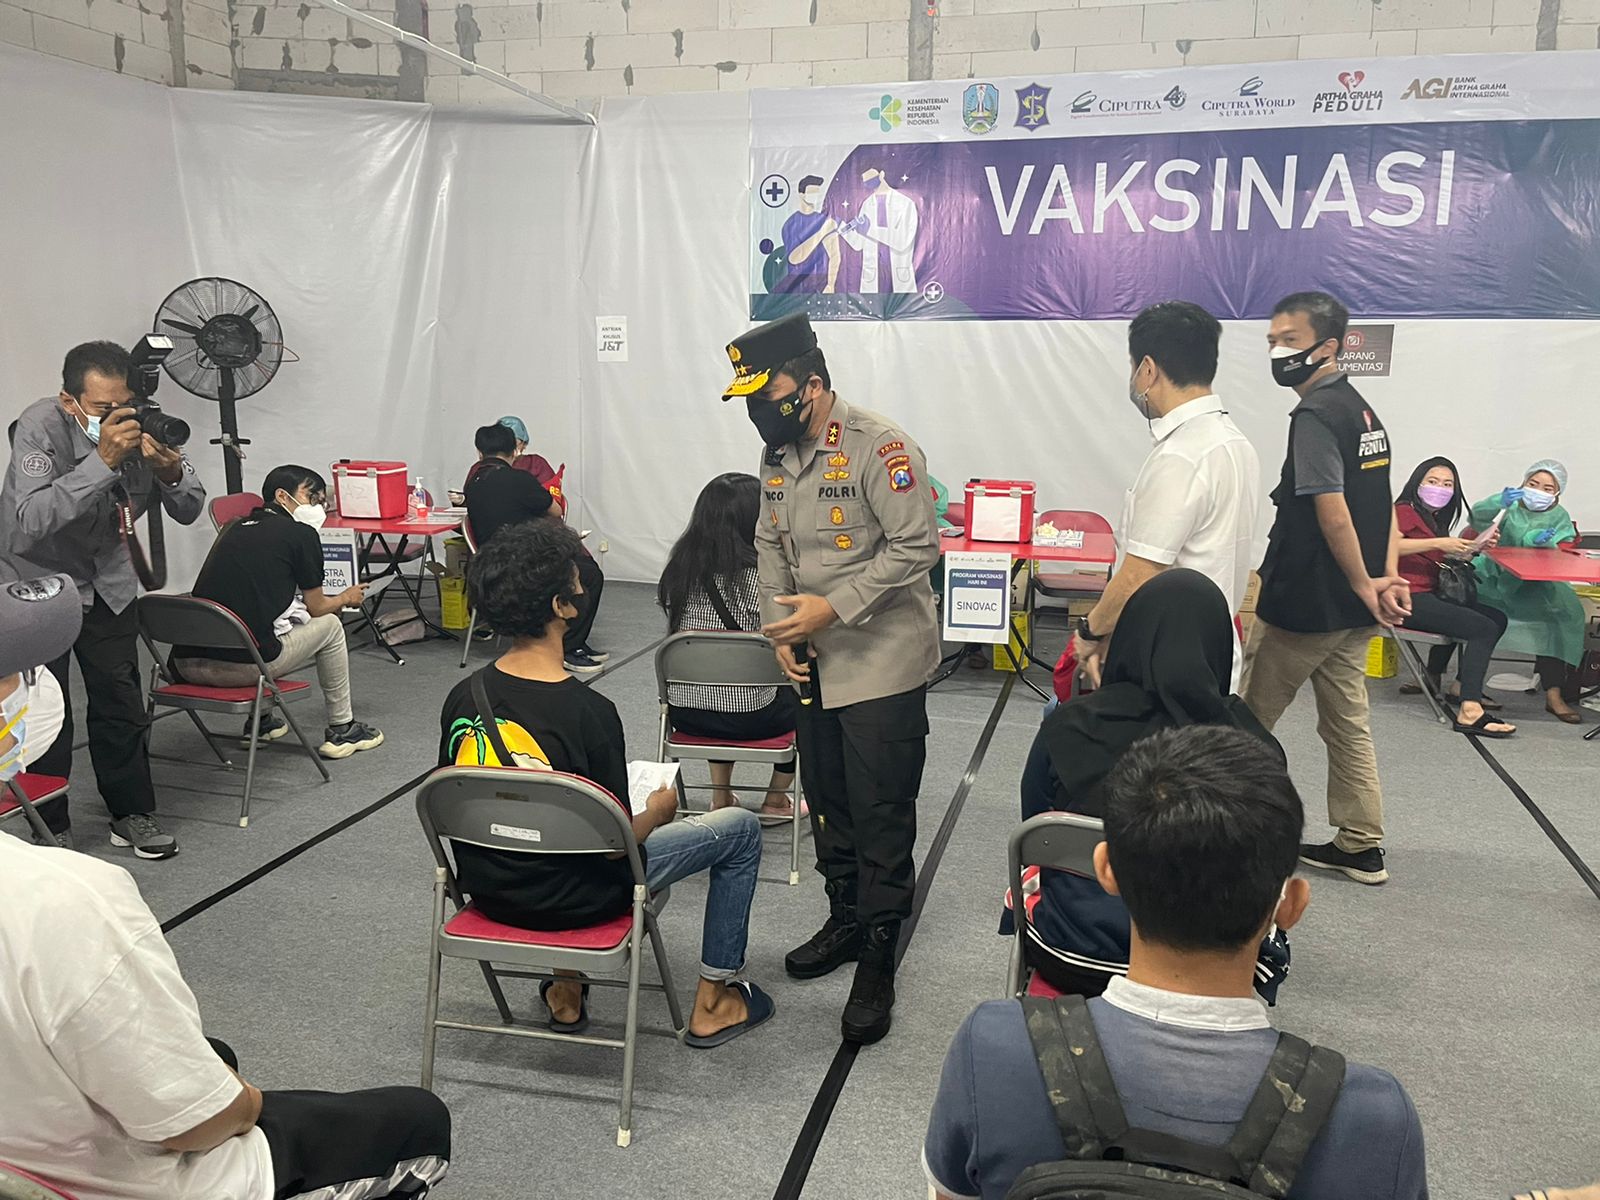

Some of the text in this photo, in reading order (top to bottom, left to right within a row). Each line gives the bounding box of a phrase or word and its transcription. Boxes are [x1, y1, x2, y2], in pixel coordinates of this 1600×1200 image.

[1315, 90, 1383, 101] ARTHA GRAHA
[1400, 78, 1453, 100] AGI
[907, 97, 949, 105] KEMENTERIAN
[1099, 99, 1161, 113] CIPUTRA
[1201, 98, 1295, 111] CIPUTRA WORLD
[1312, 99, 1383, 113] PEDULI
[1219, 109, 1275, 117] SURABAYA
[984, 150, 1456, 236] VAKSINASI
[599, 341, 624, 351] J&T
[818, 485, 857, 498] POLRI
[956, 601, 998, 612] SINOVAC
